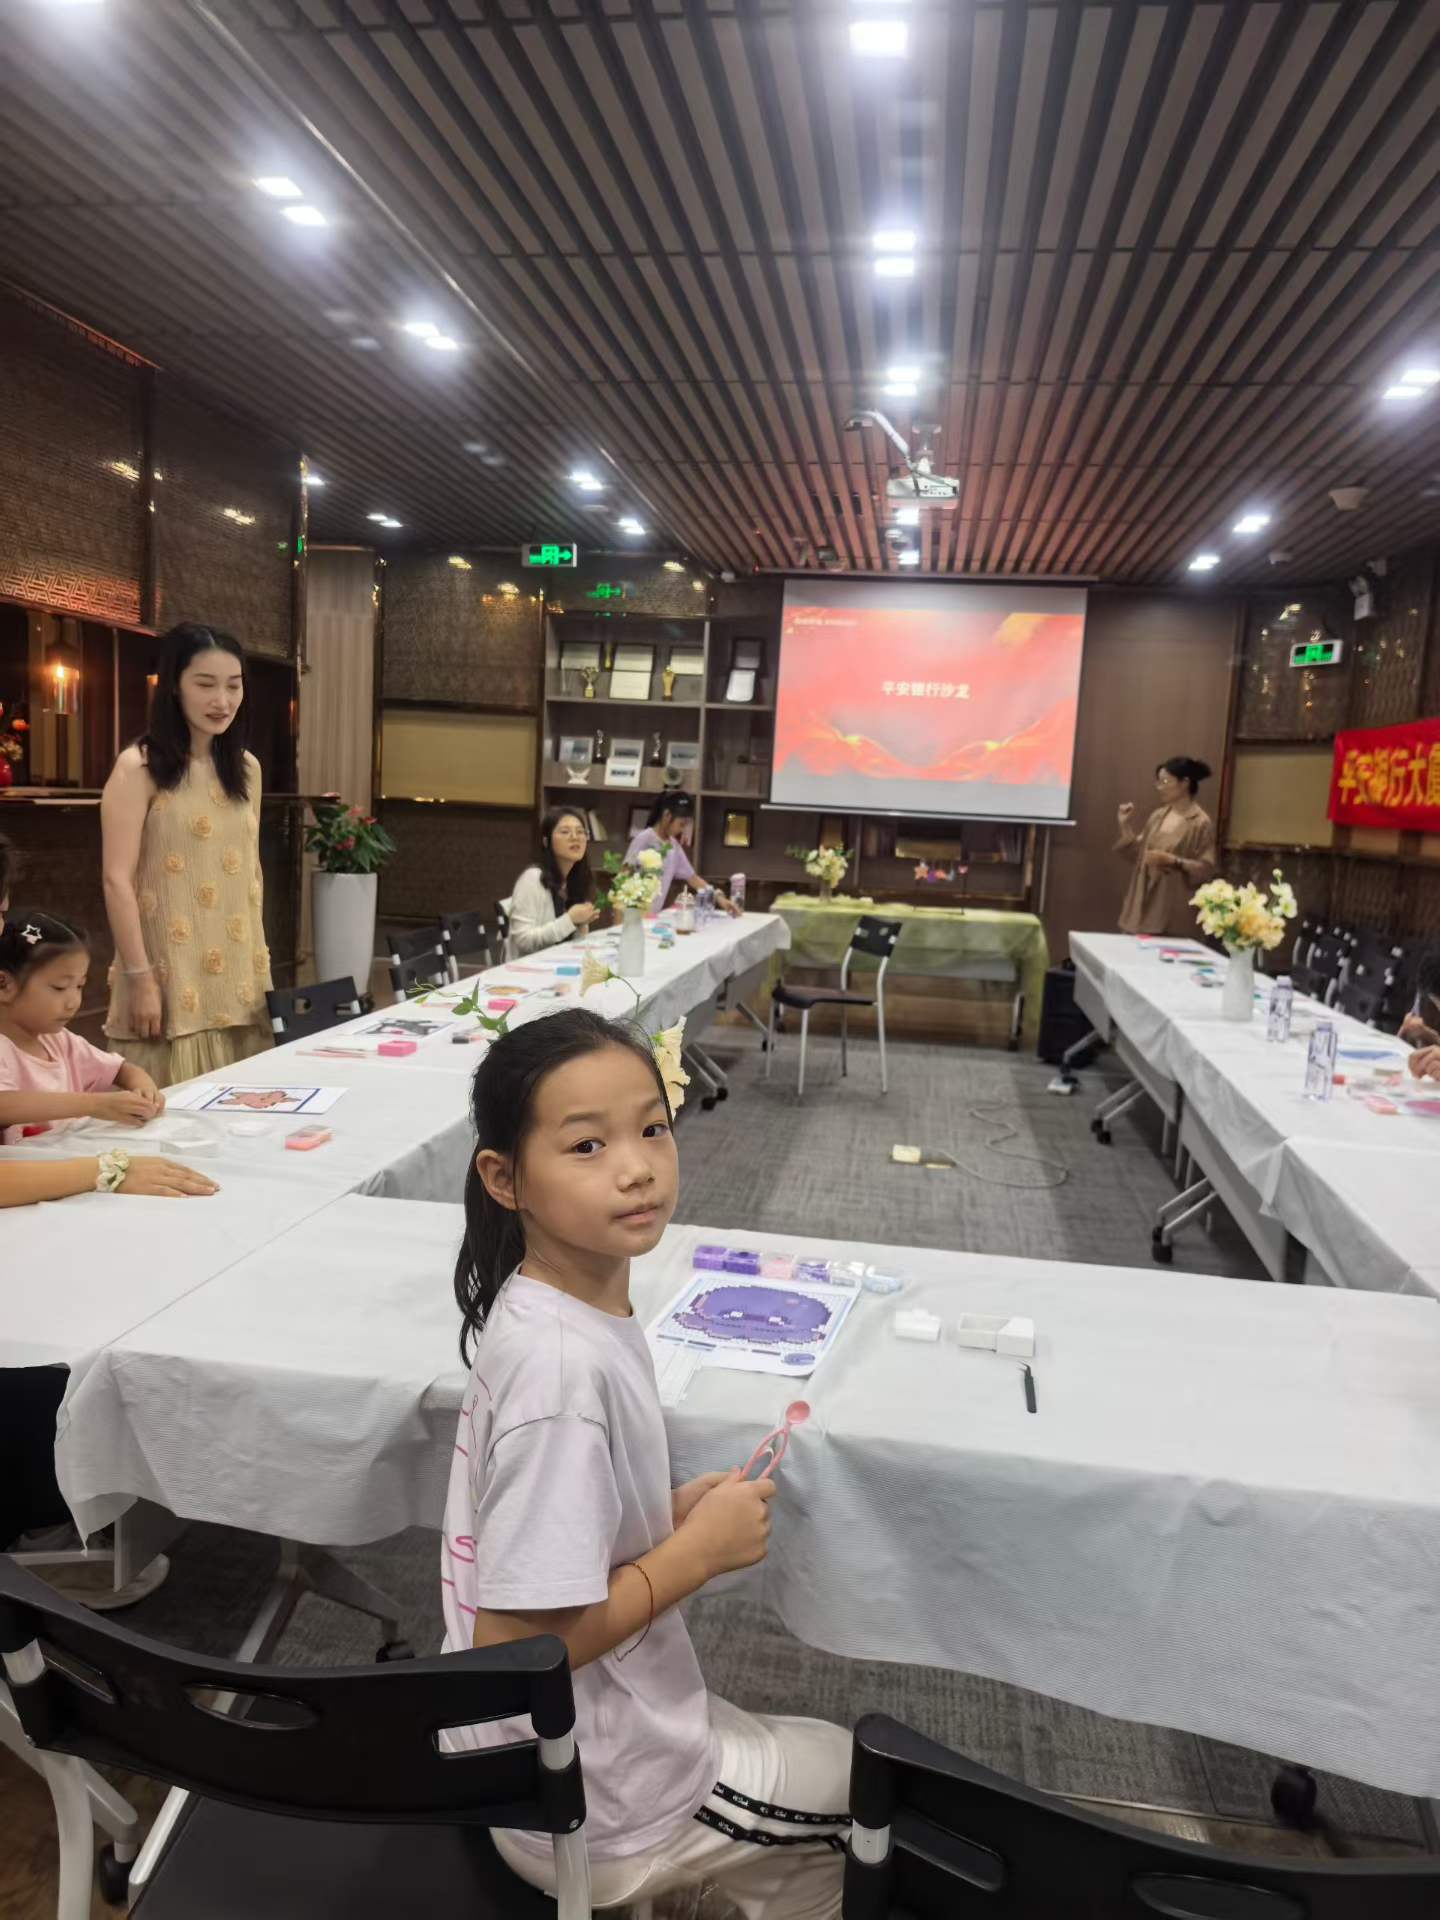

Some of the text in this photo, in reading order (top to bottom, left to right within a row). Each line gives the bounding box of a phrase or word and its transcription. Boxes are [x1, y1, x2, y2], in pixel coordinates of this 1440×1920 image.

[882, 680, 970, 700] 平安银行沙龙
